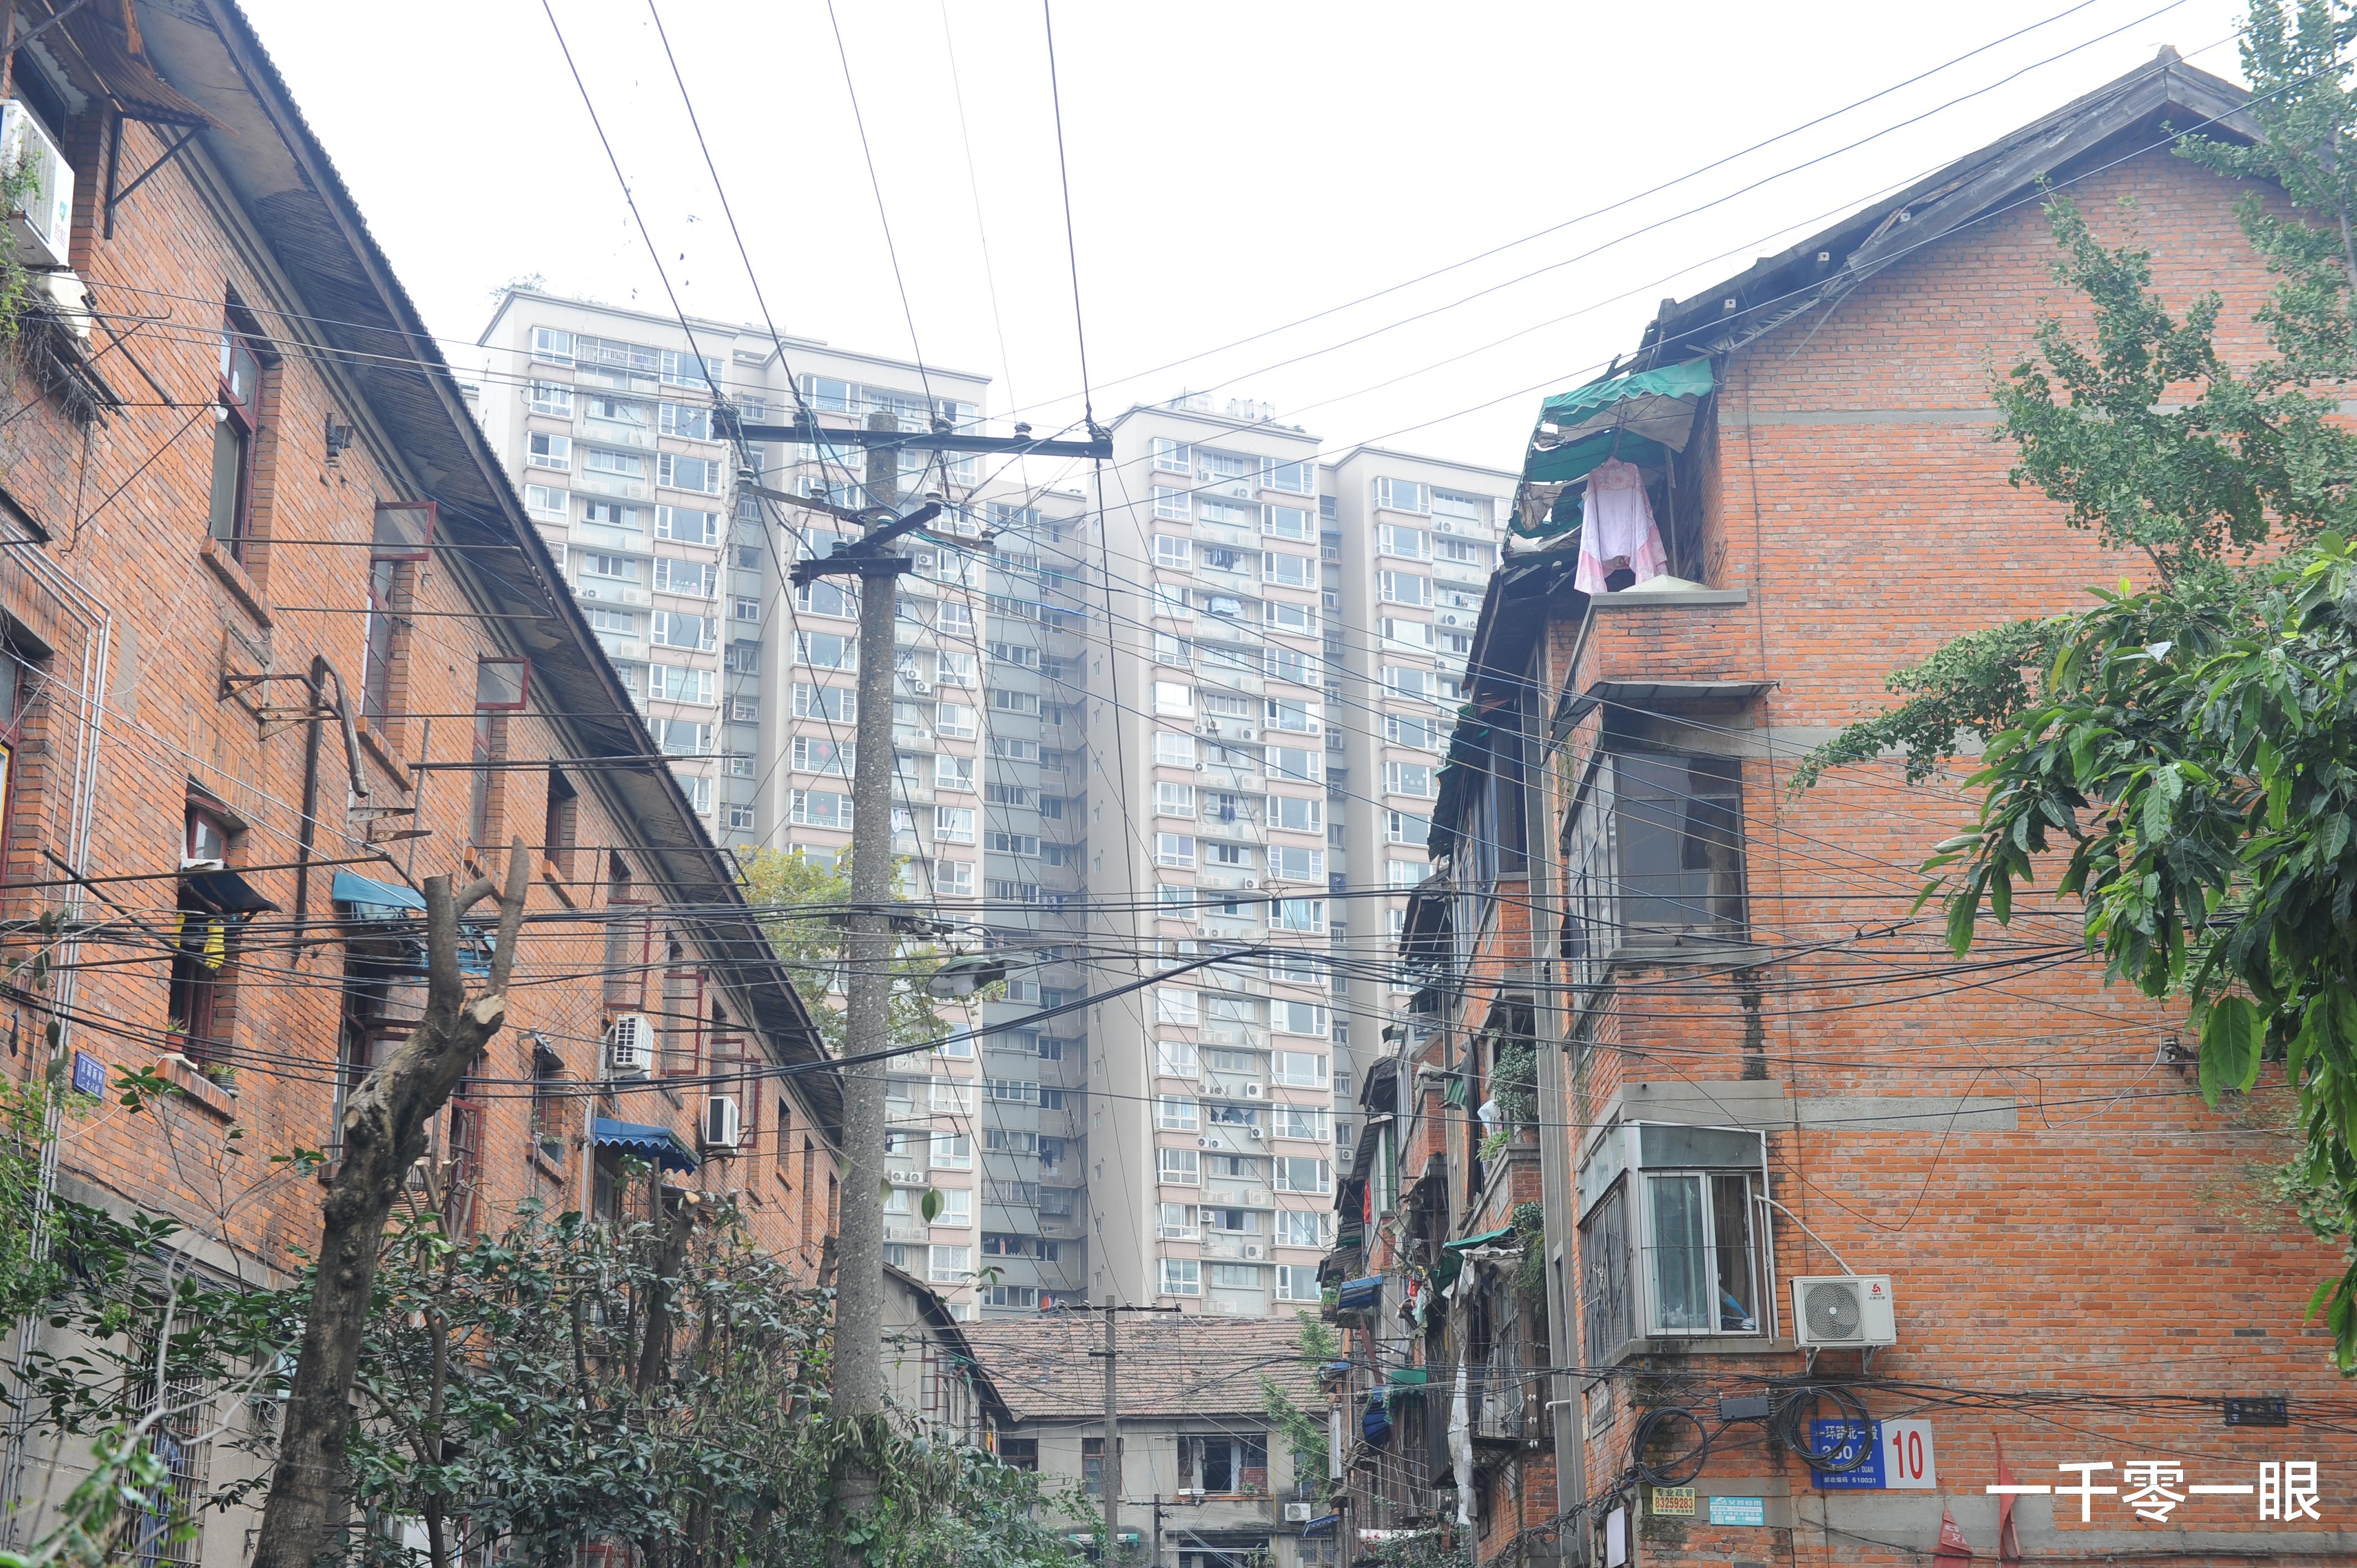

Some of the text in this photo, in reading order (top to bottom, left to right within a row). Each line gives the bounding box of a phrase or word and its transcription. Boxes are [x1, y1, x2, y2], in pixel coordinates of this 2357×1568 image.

[1892, 1430, 1923, 1479] 10
[1656, 1488, 1694, 1497] 专业疏管
[1655, 1497, 1693, 1509] 83259283
